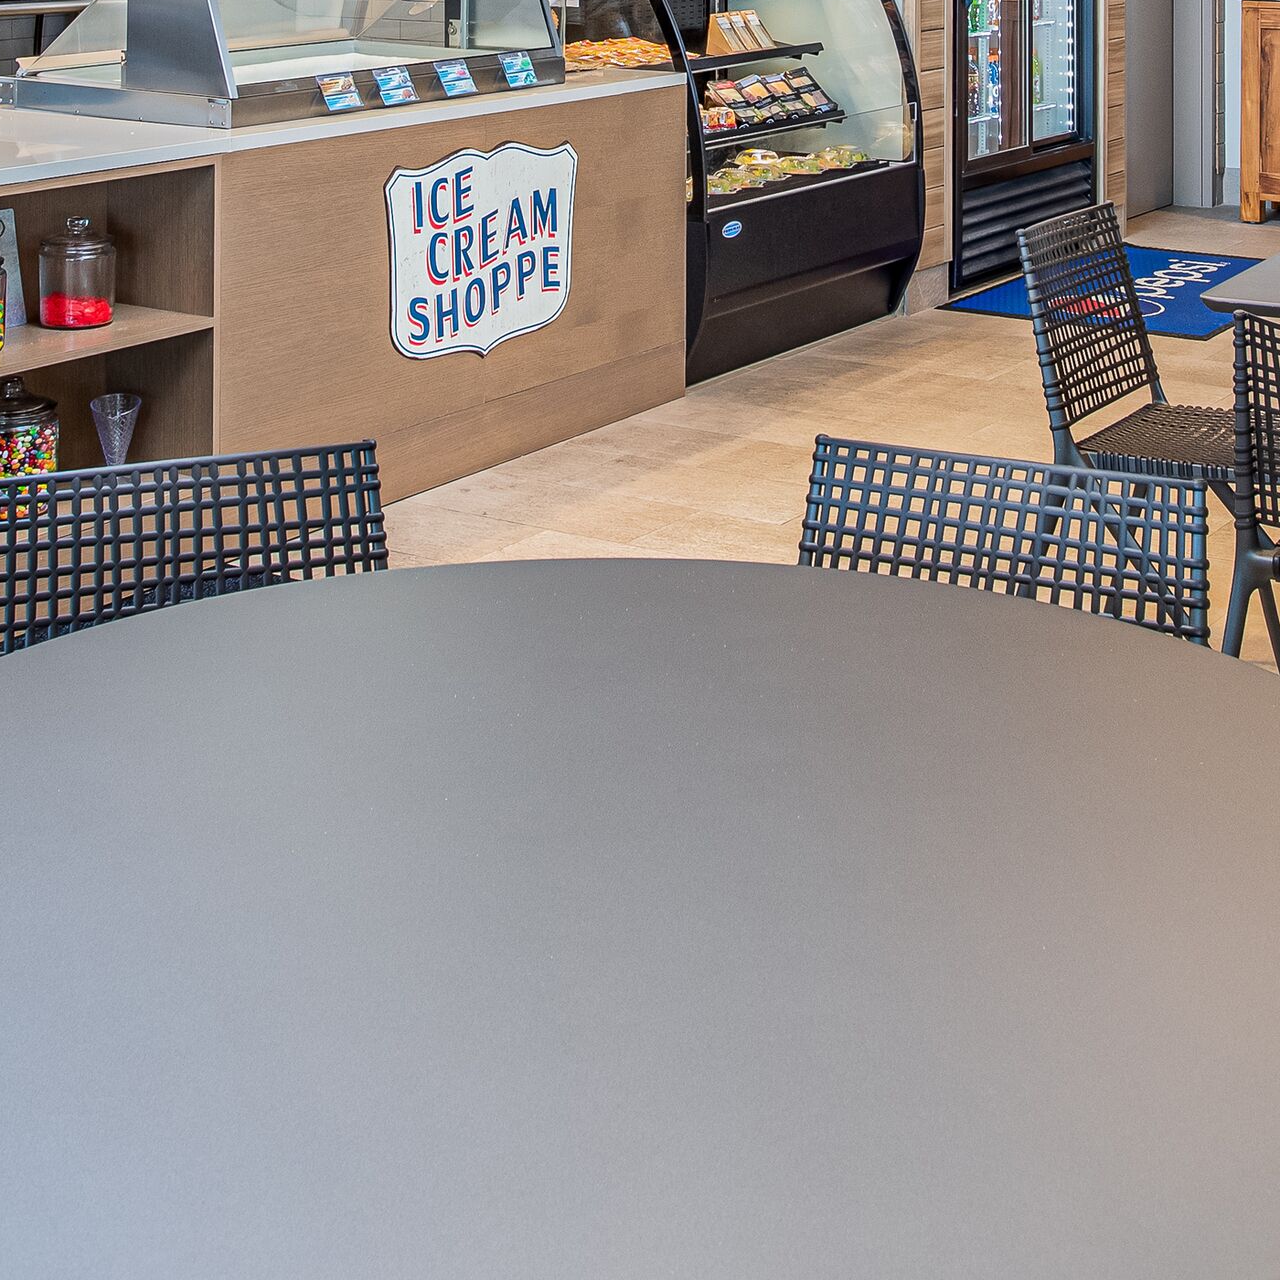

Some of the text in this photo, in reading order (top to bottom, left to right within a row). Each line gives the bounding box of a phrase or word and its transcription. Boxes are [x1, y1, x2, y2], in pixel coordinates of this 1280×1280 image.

[411, 166, 474, 234] ICE
[426, 188, 558, 286] CREAM
[407, 246, 561, 346] SHOPPE
[1133, 258, 1227, 300] pepsi
